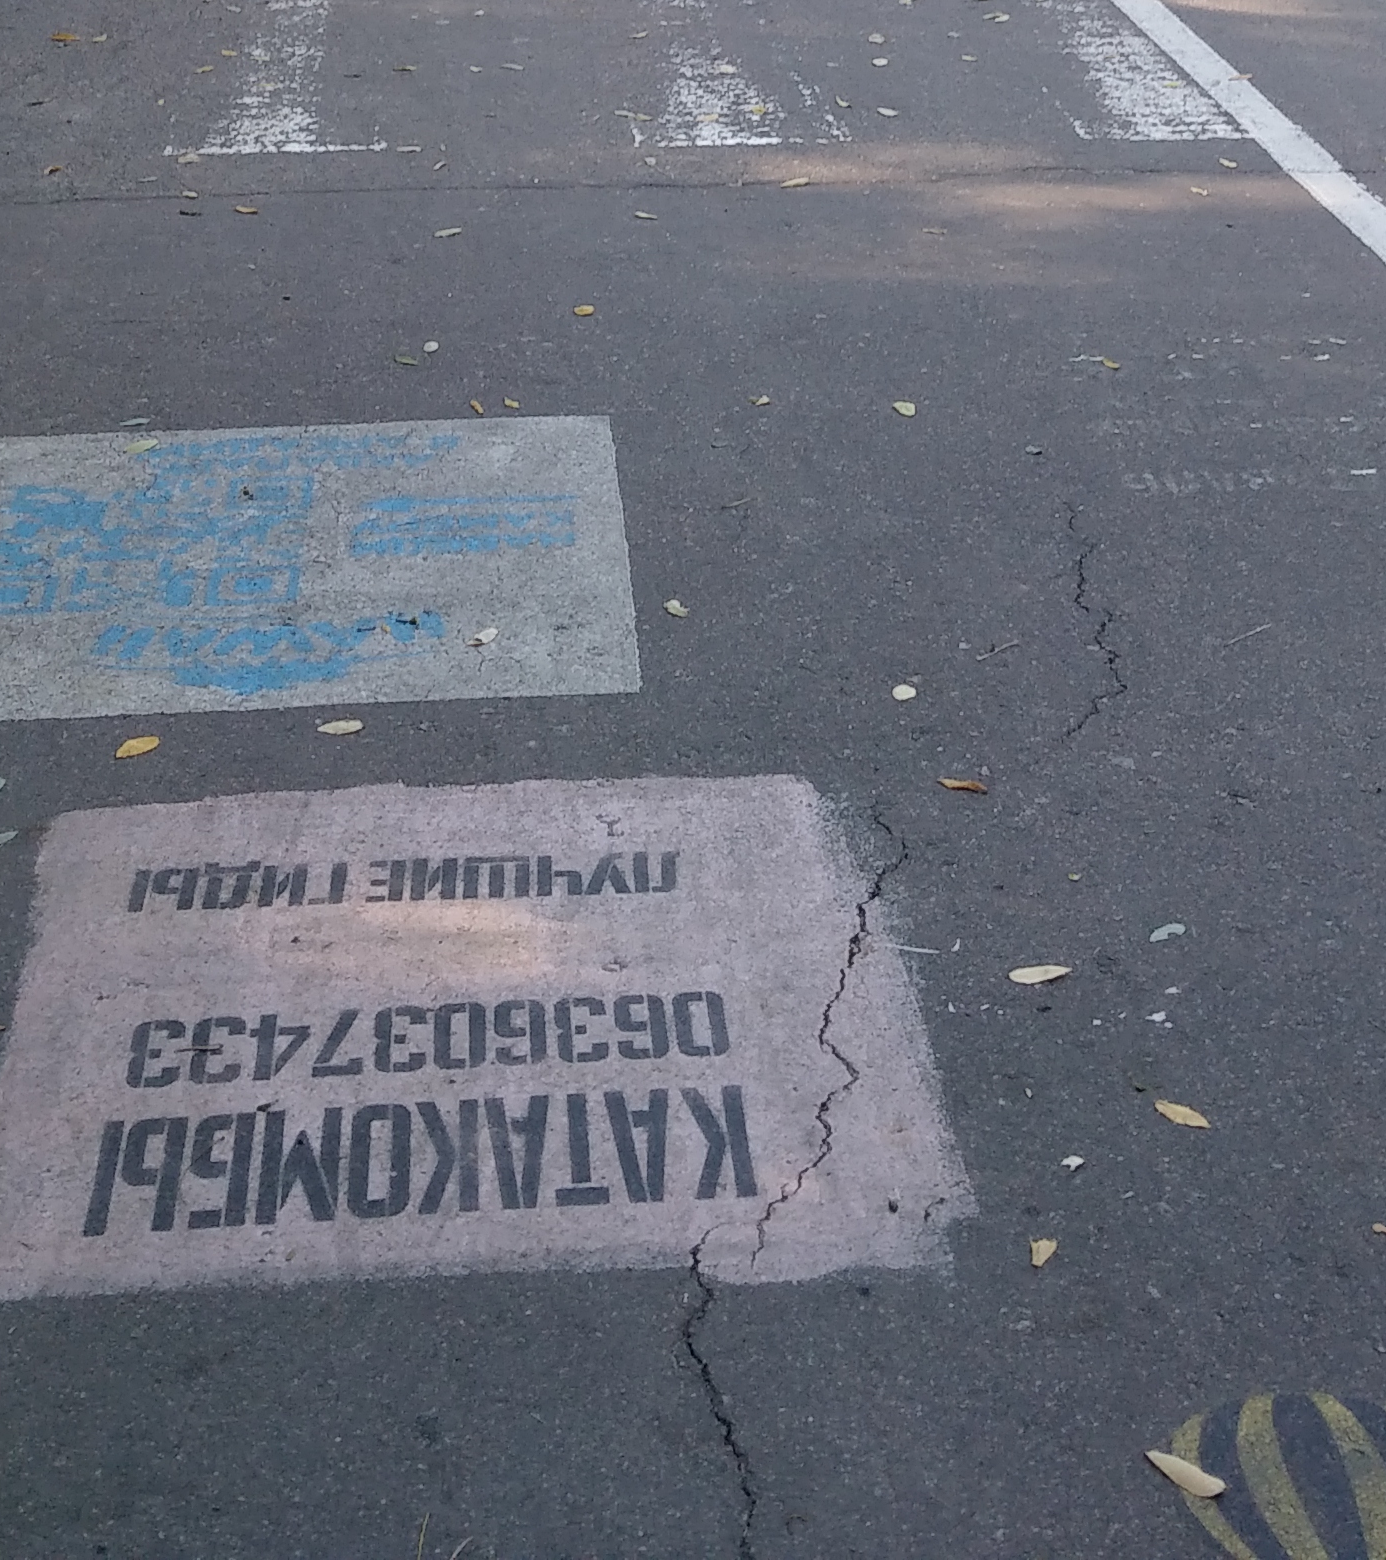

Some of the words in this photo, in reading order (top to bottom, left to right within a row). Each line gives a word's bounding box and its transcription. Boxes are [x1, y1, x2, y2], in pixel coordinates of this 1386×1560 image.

[94, 612, 443, 661] HAWAII
[128, 861, 346, 912] ГИДЫ
[372, 855, 675, 900] ЛУЧШИЕ
[126, 993, 728, 1088] 0636037433
[82, 1088, 757, 1237] КАТАКОМБЫ
